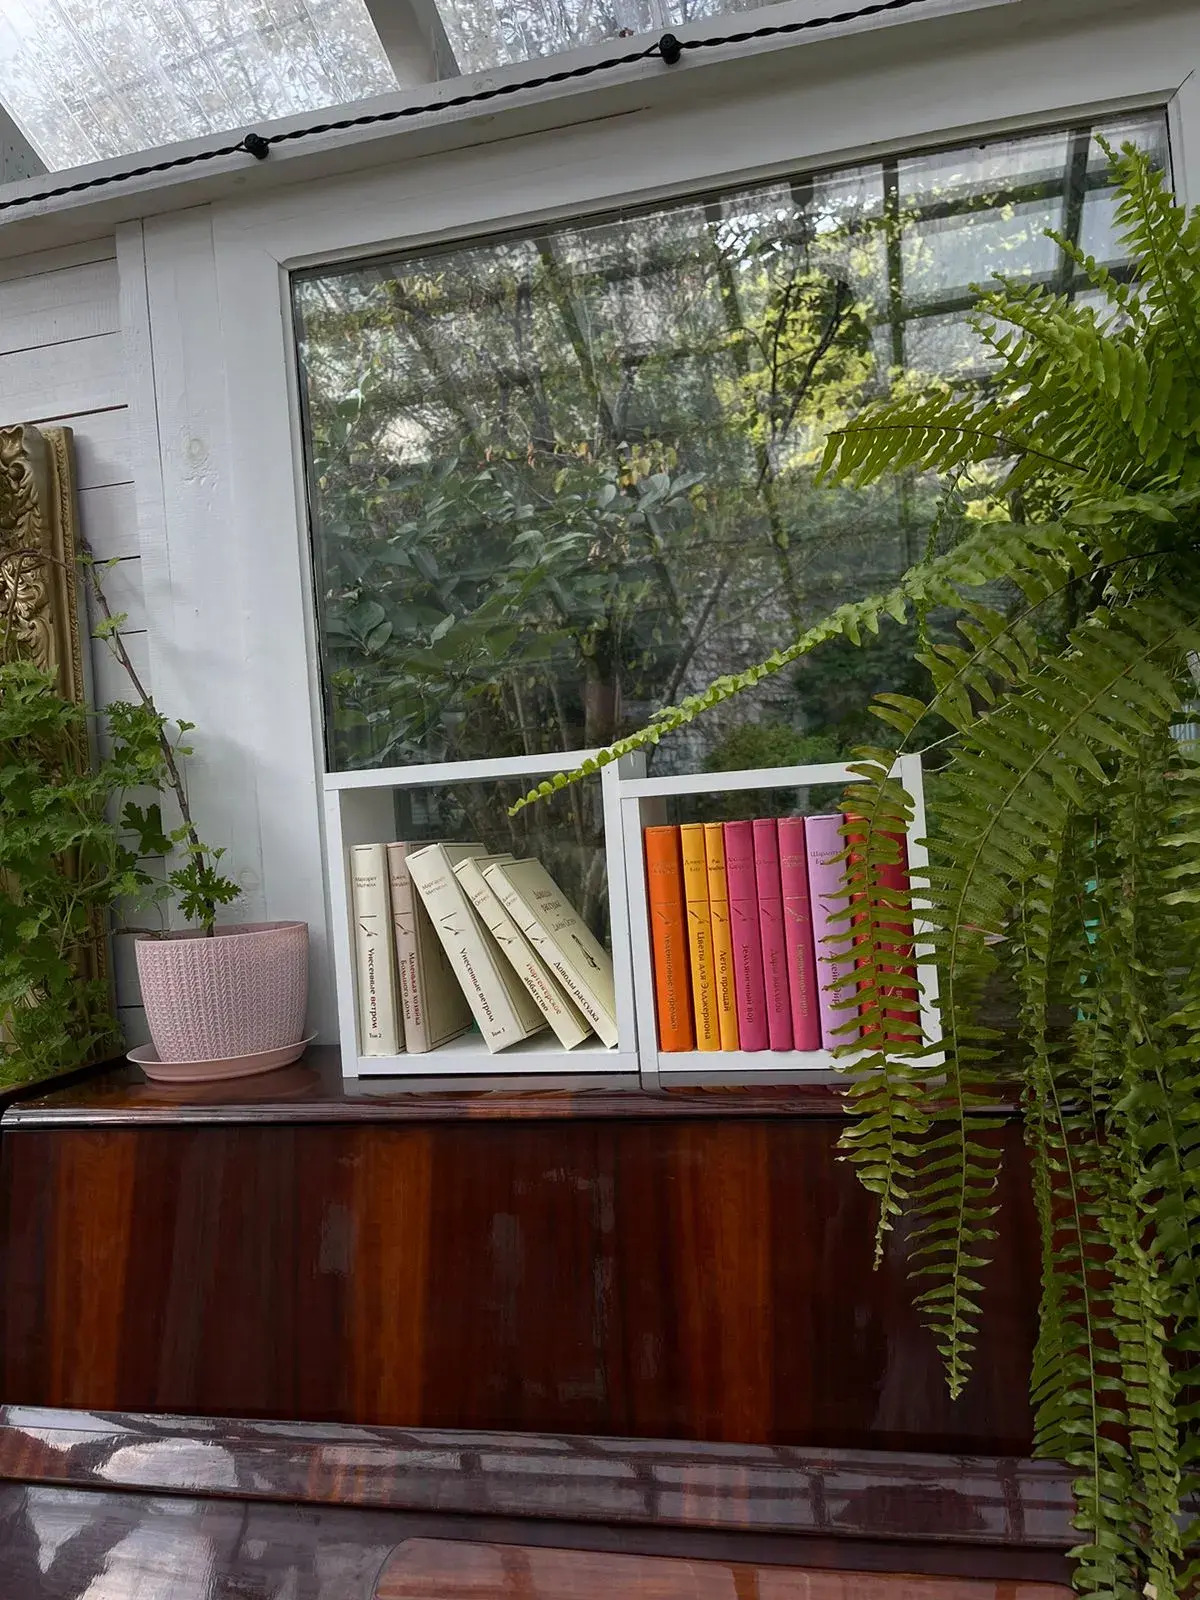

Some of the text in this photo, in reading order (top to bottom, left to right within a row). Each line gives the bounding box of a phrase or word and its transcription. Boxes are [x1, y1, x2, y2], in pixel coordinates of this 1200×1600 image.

[400, 959, 411, 1020] Большого дома
[408, 951, 421, 1026] Маленькая хозяйка
[478, 992, 495, 1023] ветром
[524, 976, 549, 1012] аббатство
[525, 962, 562, 1015] Нортенгерское
[553, 961, 576, 990] Доводы
[573, 989, 600, 1023] рассудка
[697, 931, 711, 1040] Цветы для Элджернона
[719, 950, 731, 1012] Лето, прощай
[369, 996, 378, 1029] ветром
